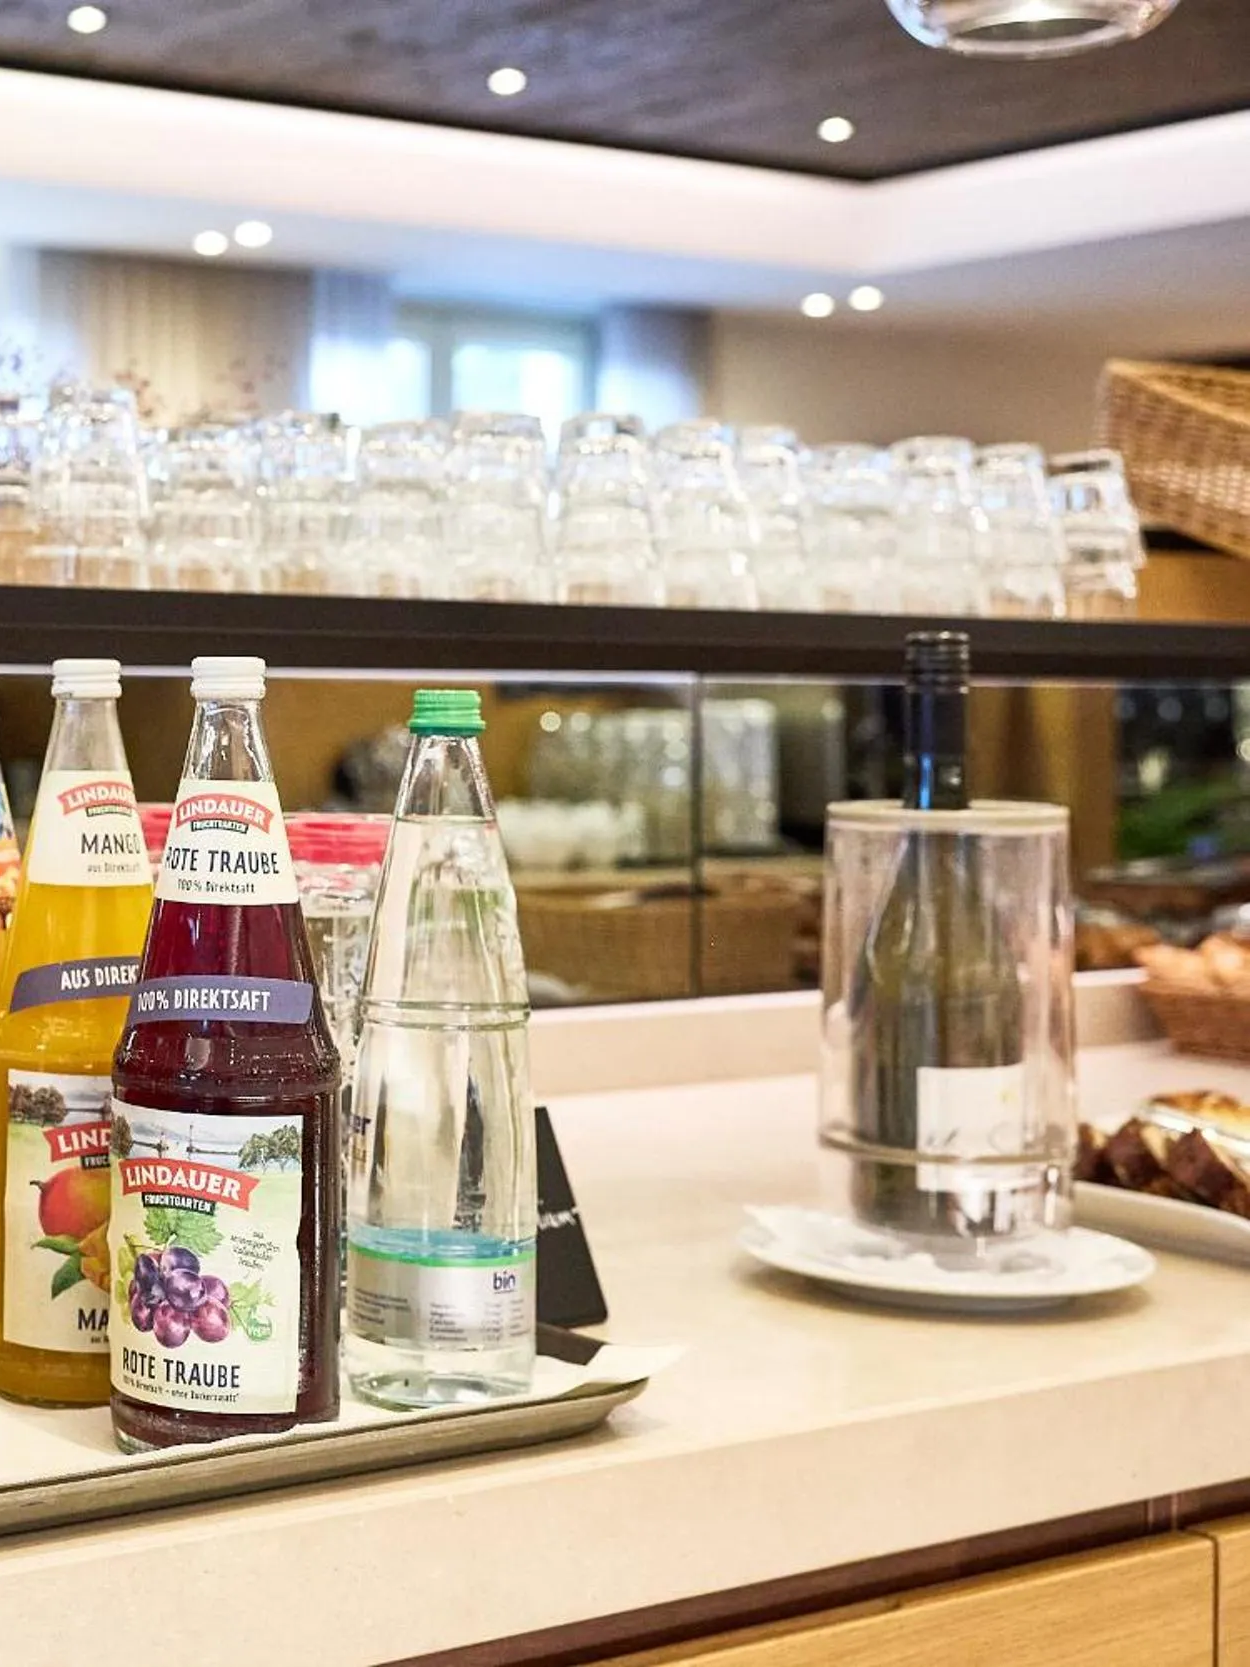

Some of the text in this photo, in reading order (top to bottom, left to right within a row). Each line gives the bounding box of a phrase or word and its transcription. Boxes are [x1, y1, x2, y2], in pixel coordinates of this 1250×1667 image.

[179, 798, 266, 824] LINDAUER
[208, 850, 280, 874] TRAUBE
[61, 964, 140, 990] AUS DIREK
[138, 989, 271, 1012] 100% DIREKTSAFT
[57, 1129, 111, 1153] LIND
[125, 1166, 240, 1200] LINDAUER
[122, 1347, 241, 1389] ROTE TRAUBE
